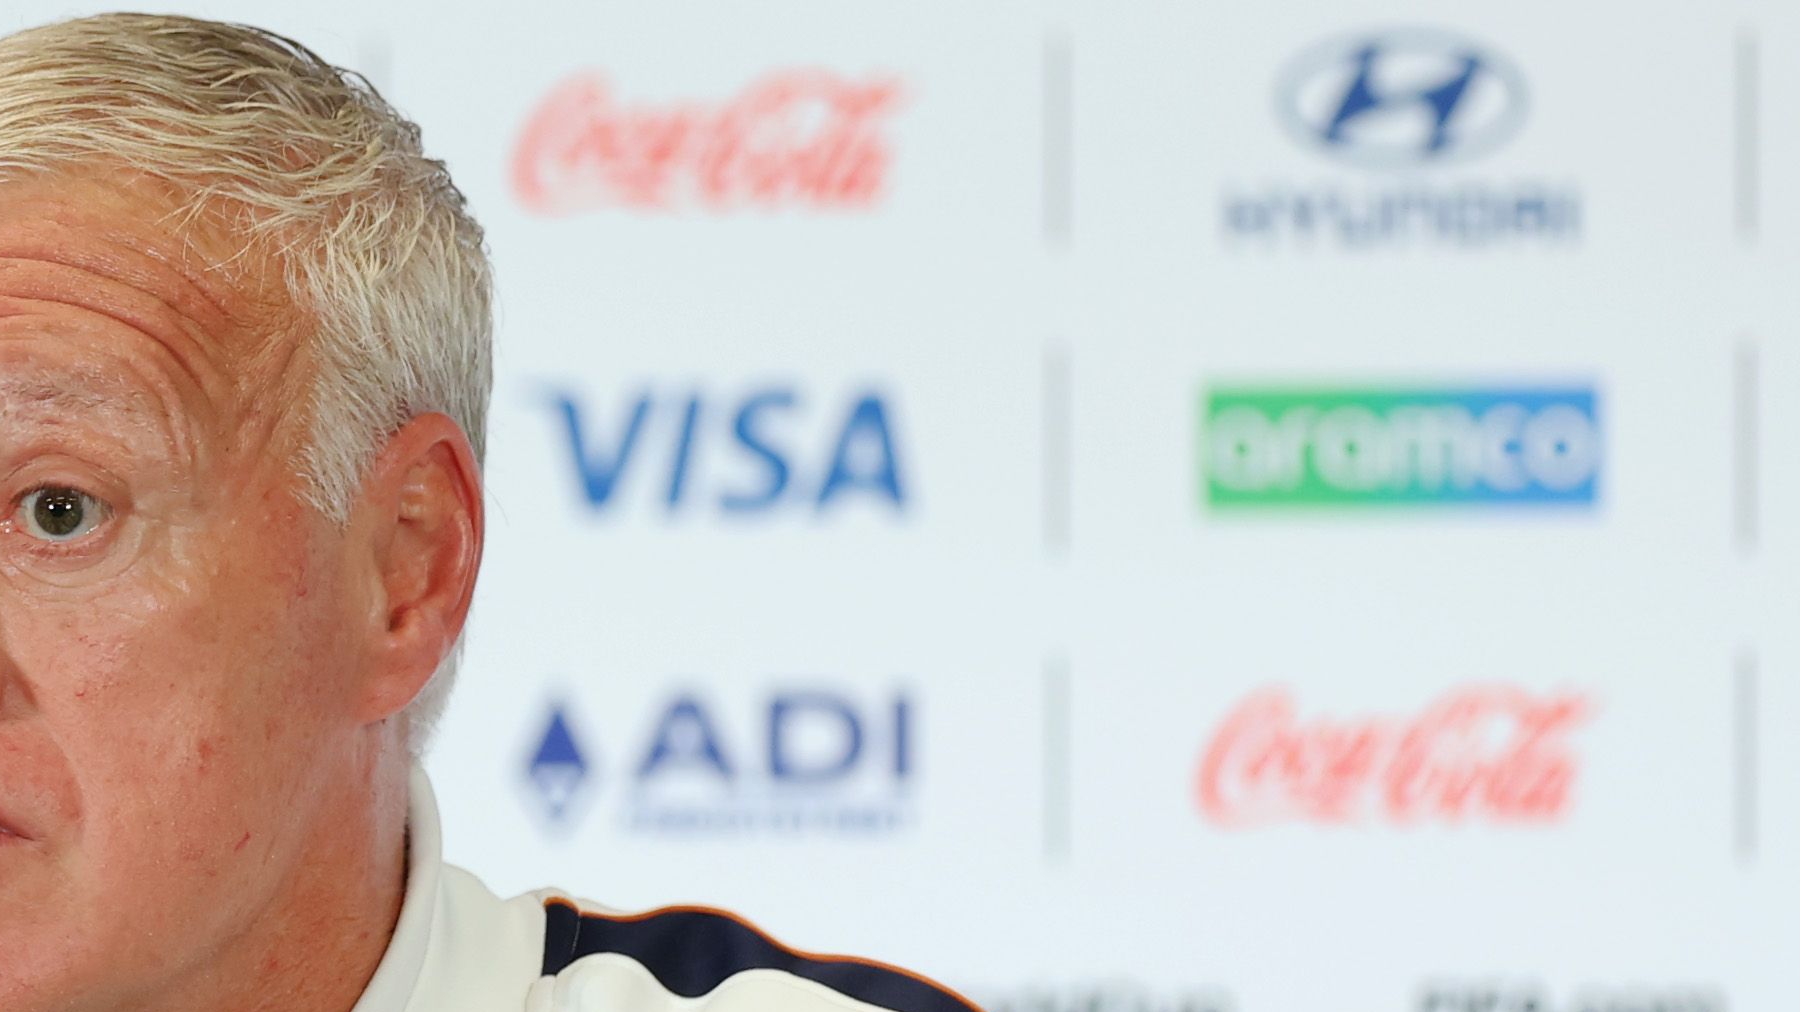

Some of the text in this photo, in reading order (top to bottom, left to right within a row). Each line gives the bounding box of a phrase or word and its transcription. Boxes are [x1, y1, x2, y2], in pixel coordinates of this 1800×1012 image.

[532, 383, 912, 518] VISA
[1203, 402, 1598, 494] aramco
[630, 690, 916, 785] ADI
[1194, 682, 1594, 825] Coca-Cola
